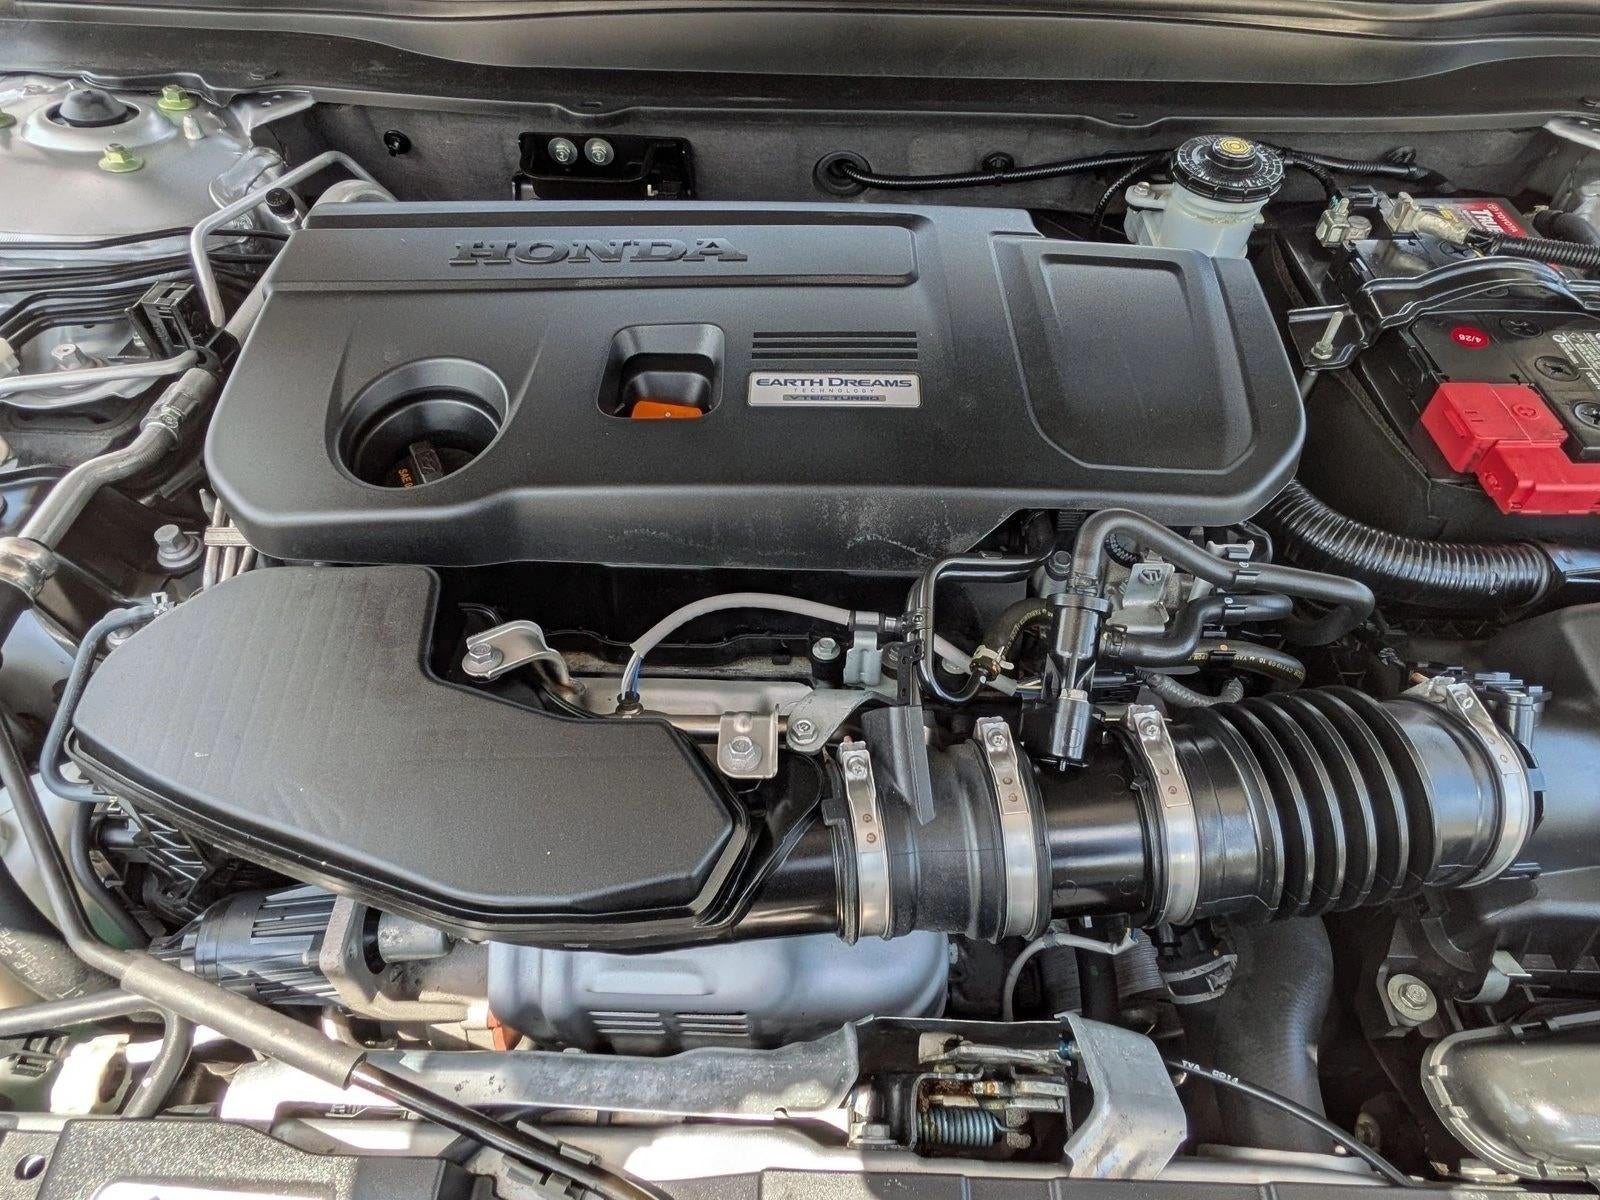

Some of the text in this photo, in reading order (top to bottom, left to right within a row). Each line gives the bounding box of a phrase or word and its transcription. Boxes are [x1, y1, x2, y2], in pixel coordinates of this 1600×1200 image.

[1497, 210, 1519, 233] TOYOTA
[449, 238, 748, 264] HONDA
[756, 377, 912, 388] EARTH DREAMS
[1181, 1059, 1201, 1072] TVA
